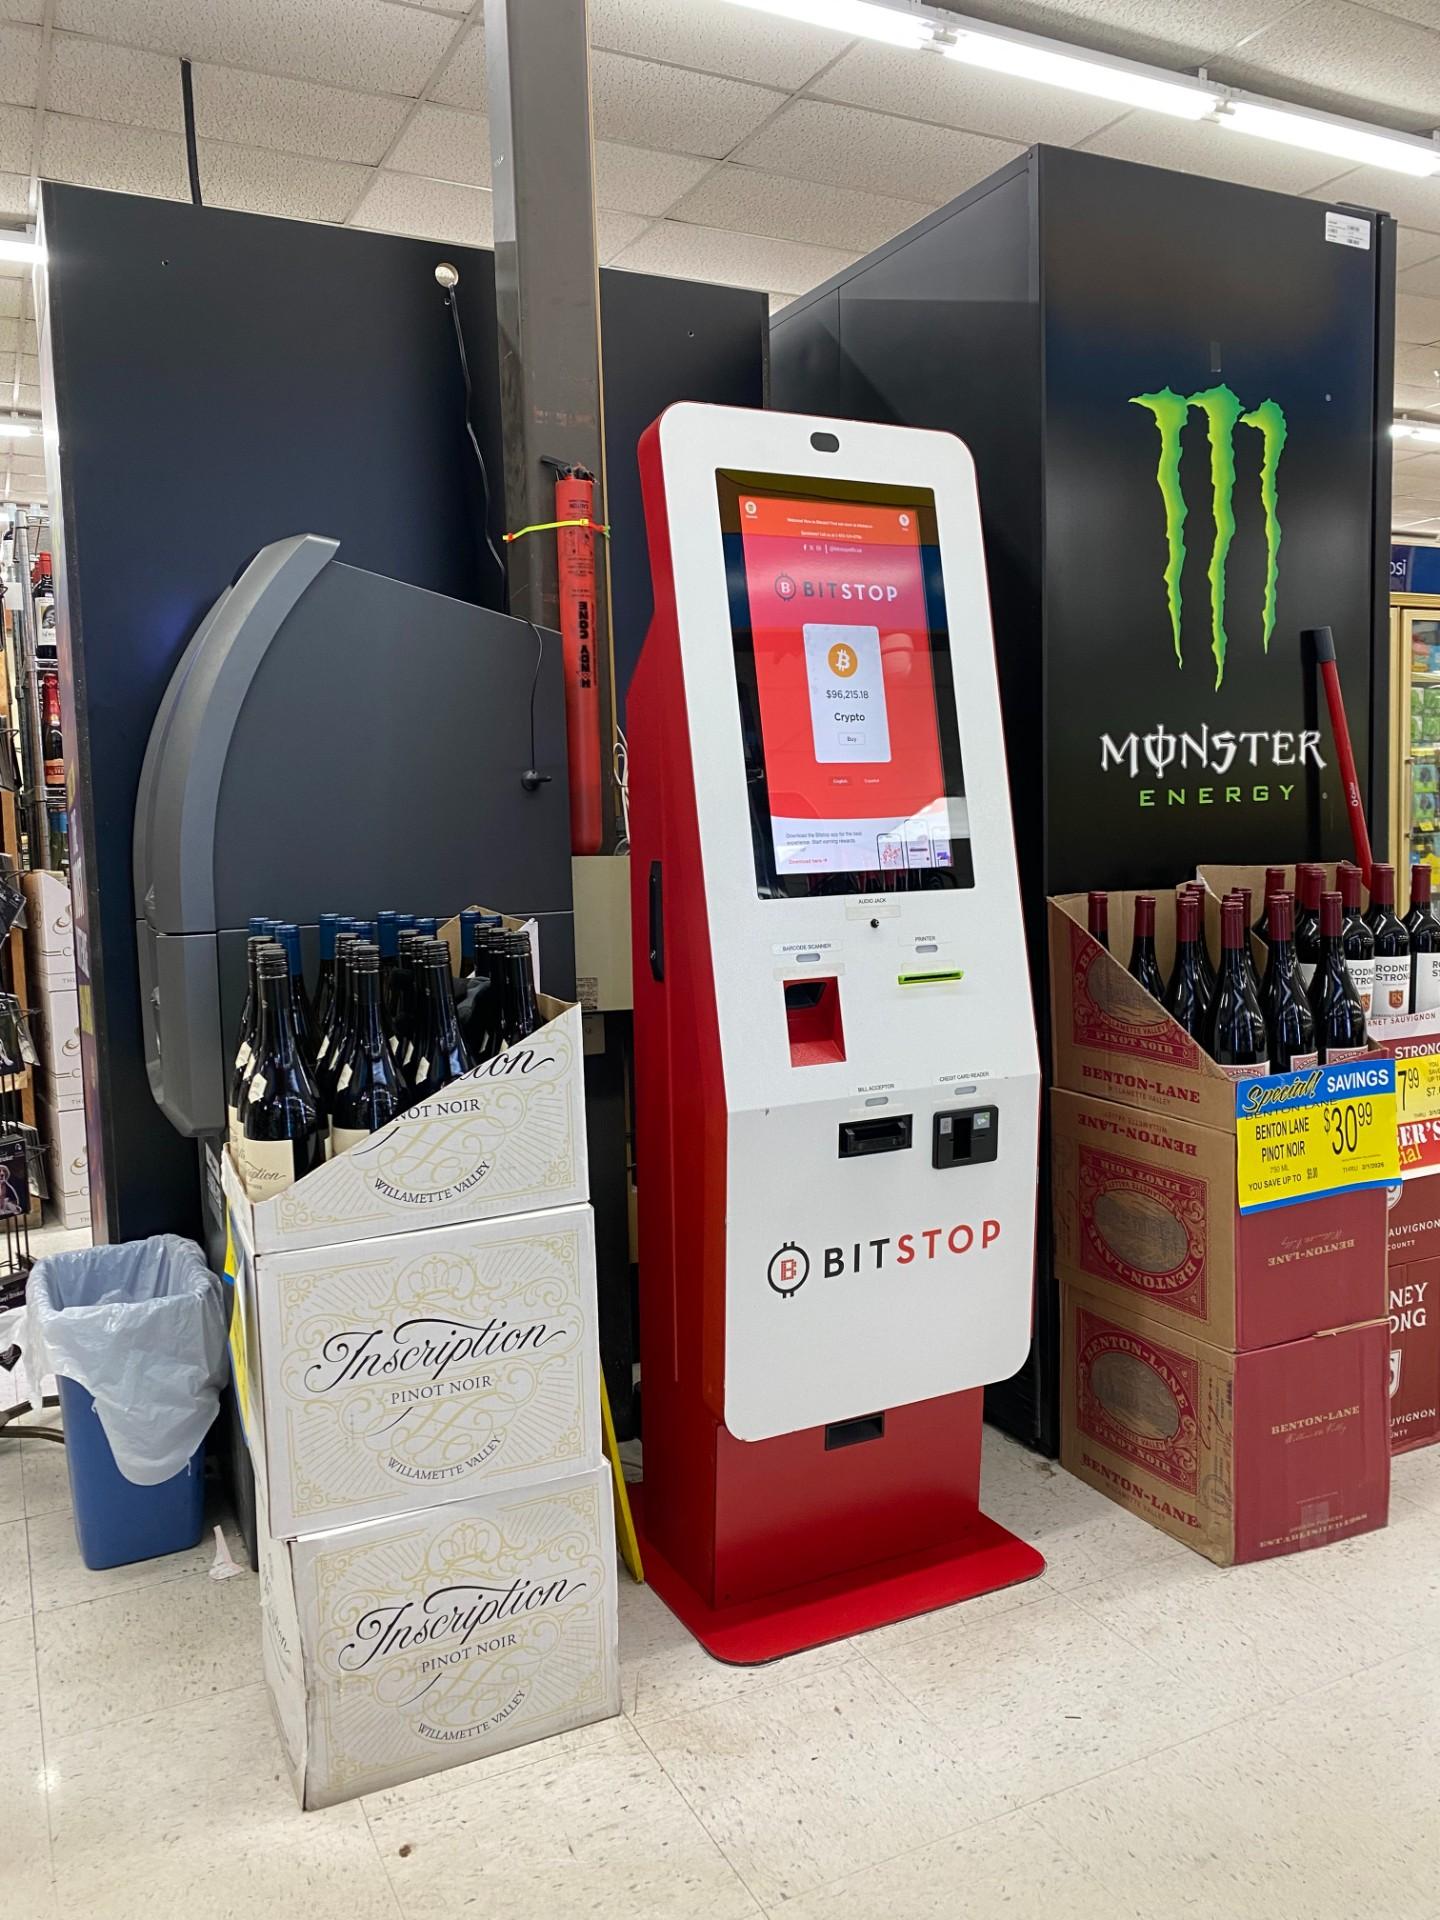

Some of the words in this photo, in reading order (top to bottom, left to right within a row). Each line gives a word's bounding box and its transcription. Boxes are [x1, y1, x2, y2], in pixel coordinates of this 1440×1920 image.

[803, 581, 898, 602] BITSTOP
[826, 689, 869, 700] $96,215.18
[834, 712, 866, 723] Crypto
[1100, 723, 1327, 779] MONSTER
[1139, 784, 1295, 807] ENERGY
[1391, 1013, 1436, 1025] SAUVIGNON
[1096, 1031, 1136, 1046] PINOT
[1139, 1039, 1175, 1055] NOIR
[1082, 1065, 1200, 1104] BENTON-LANE
[1327, 1069, 1389, 1093] SAVINGS
[437, 1099, 481, 1116] NOIR
[1077, 1113, 1198, 1157] BENTON-LANE
[1256, 1122, 1288, 1141] BENTON
[1289, 1117, 1310, 1134] LANE
[1262, 1146, 1286, 1163] PINOT
[1286, 1141, 1306, 1158] NOIR
[375, 1176, 453, 1204] WILLAMETTE
[453, 1160, 490, 1194] VALLEY
[1101, 1161, 1134, 1177] NOIR
[1135, 1171, 1181, 1192] PINOT
[1248, 1182, 1263, 1192] YOU
[1264, 1178, 1281, 1189] SAVE
[1283, 1176, 1292, 1185] UP
[1292, 1174, 1302, 1183] TO
[824, 1219, 1001, 1279] BITSTOP
[1267, 1239, 1356, 1267] BENTON-LANE
[1390, 1282, 1428, 1310] NEY
[304, 1317, 567, 1393] Inscription
[391, 1384, 446, 1405] PINOT
[449, 1374, 492, 1396] NOIR
[1271, 1405, 1360, 1435] BENTON-LANE
[386, 1456, 464, 1481] WILLAMETTE
[465, 1435, 503, 1469] VALLEY
[1095, 1423, 1133, 1452] PINOT
[1135, 1447, 1171, 1473] NOIR
[1082, 1453, 1200, 1529] BENTON-LANE
[338, 1578, 587, 1672] Inscription
[421, 1647, 472, 1674] PINOT
[476, 1633, 518, 1657] NOIR
[417, 1720, 490, 1742] WILLAMETTE
[491, 1688, 526, 1725] VALLEY
